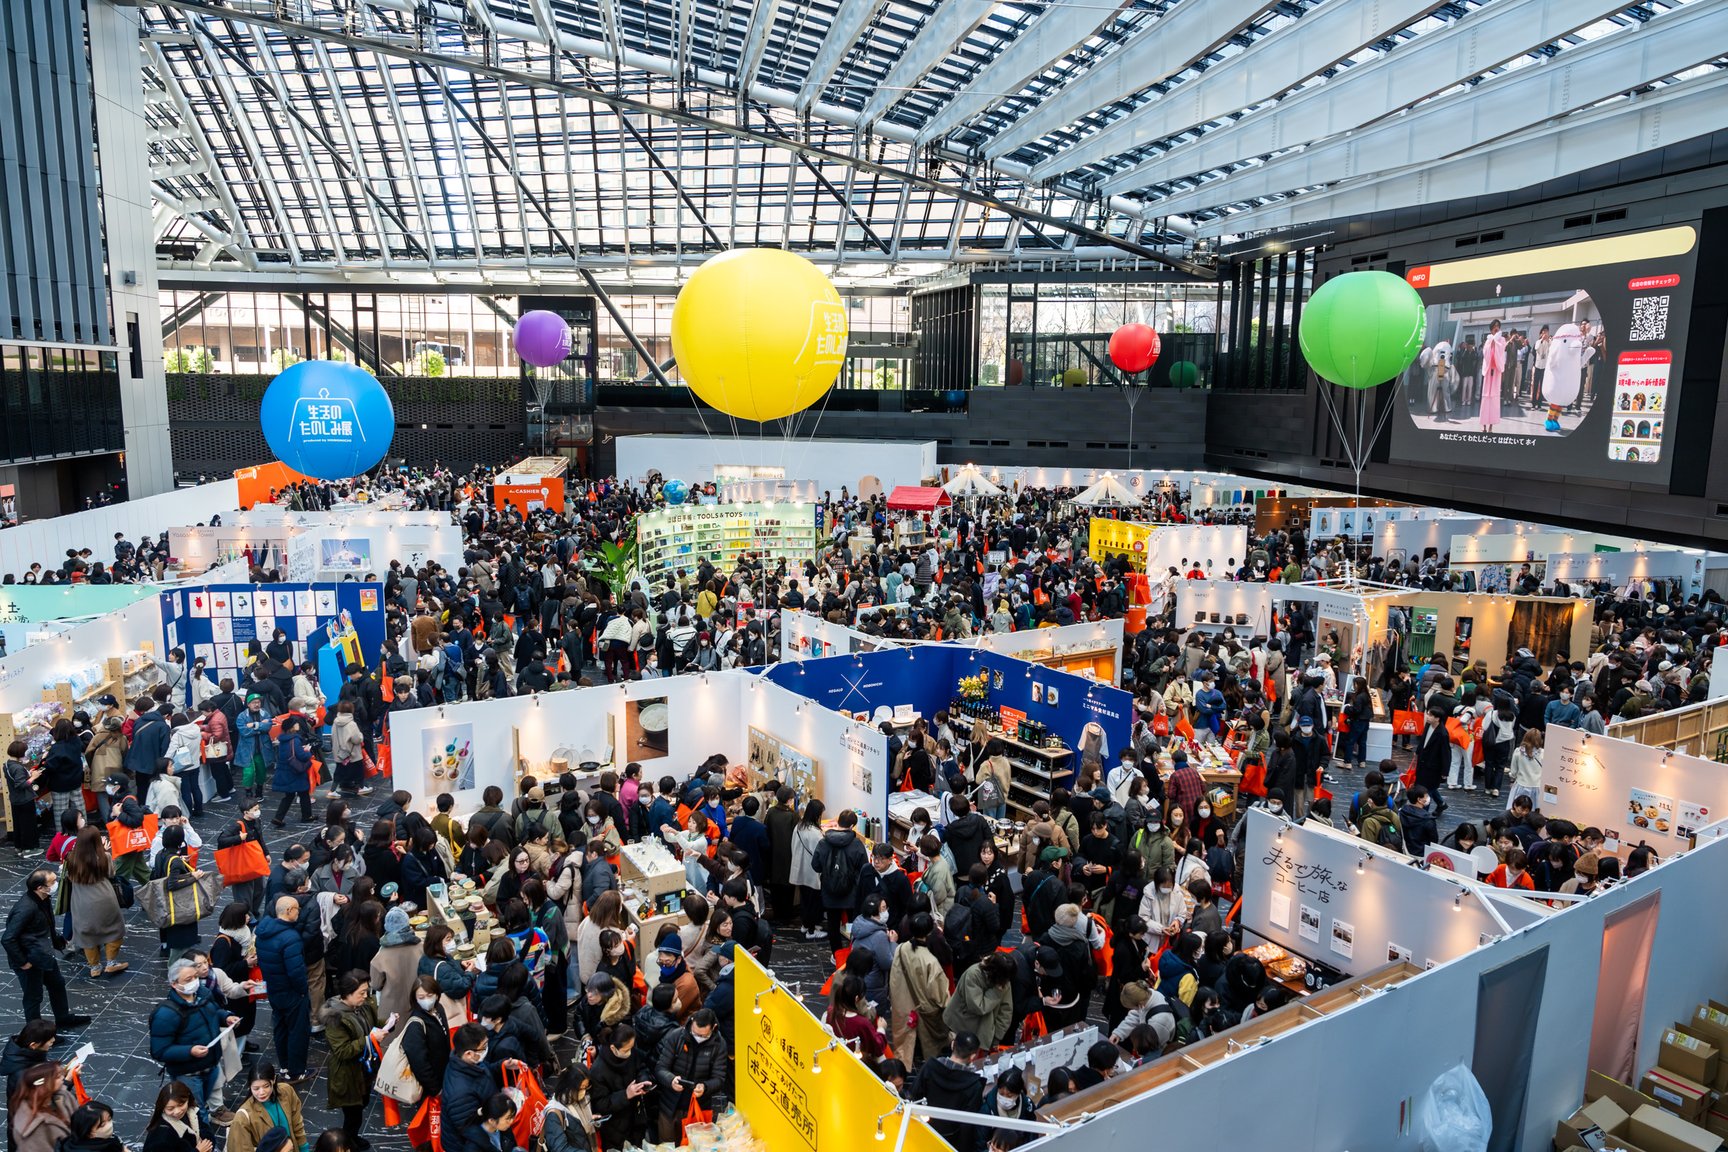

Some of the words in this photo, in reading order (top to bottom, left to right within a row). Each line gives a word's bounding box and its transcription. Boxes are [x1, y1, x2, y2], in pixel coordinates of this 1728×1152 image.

[307, 404, 342, 420] 生活の
[299, 420, 353, 436] たのしみ展
[1439, 432, 1467, 442] あなただって
[1467, 434, 1497, 444] わたしだって
[1497, 436, 1525, 446] はばたいて
[1560, 755, 1587, 767] たのしみ
[1559, 765, 1579, 775] フード
[1558, 776, 1599, 791] セレクション
[1275, 872, 1331, 904] コーヒー店
